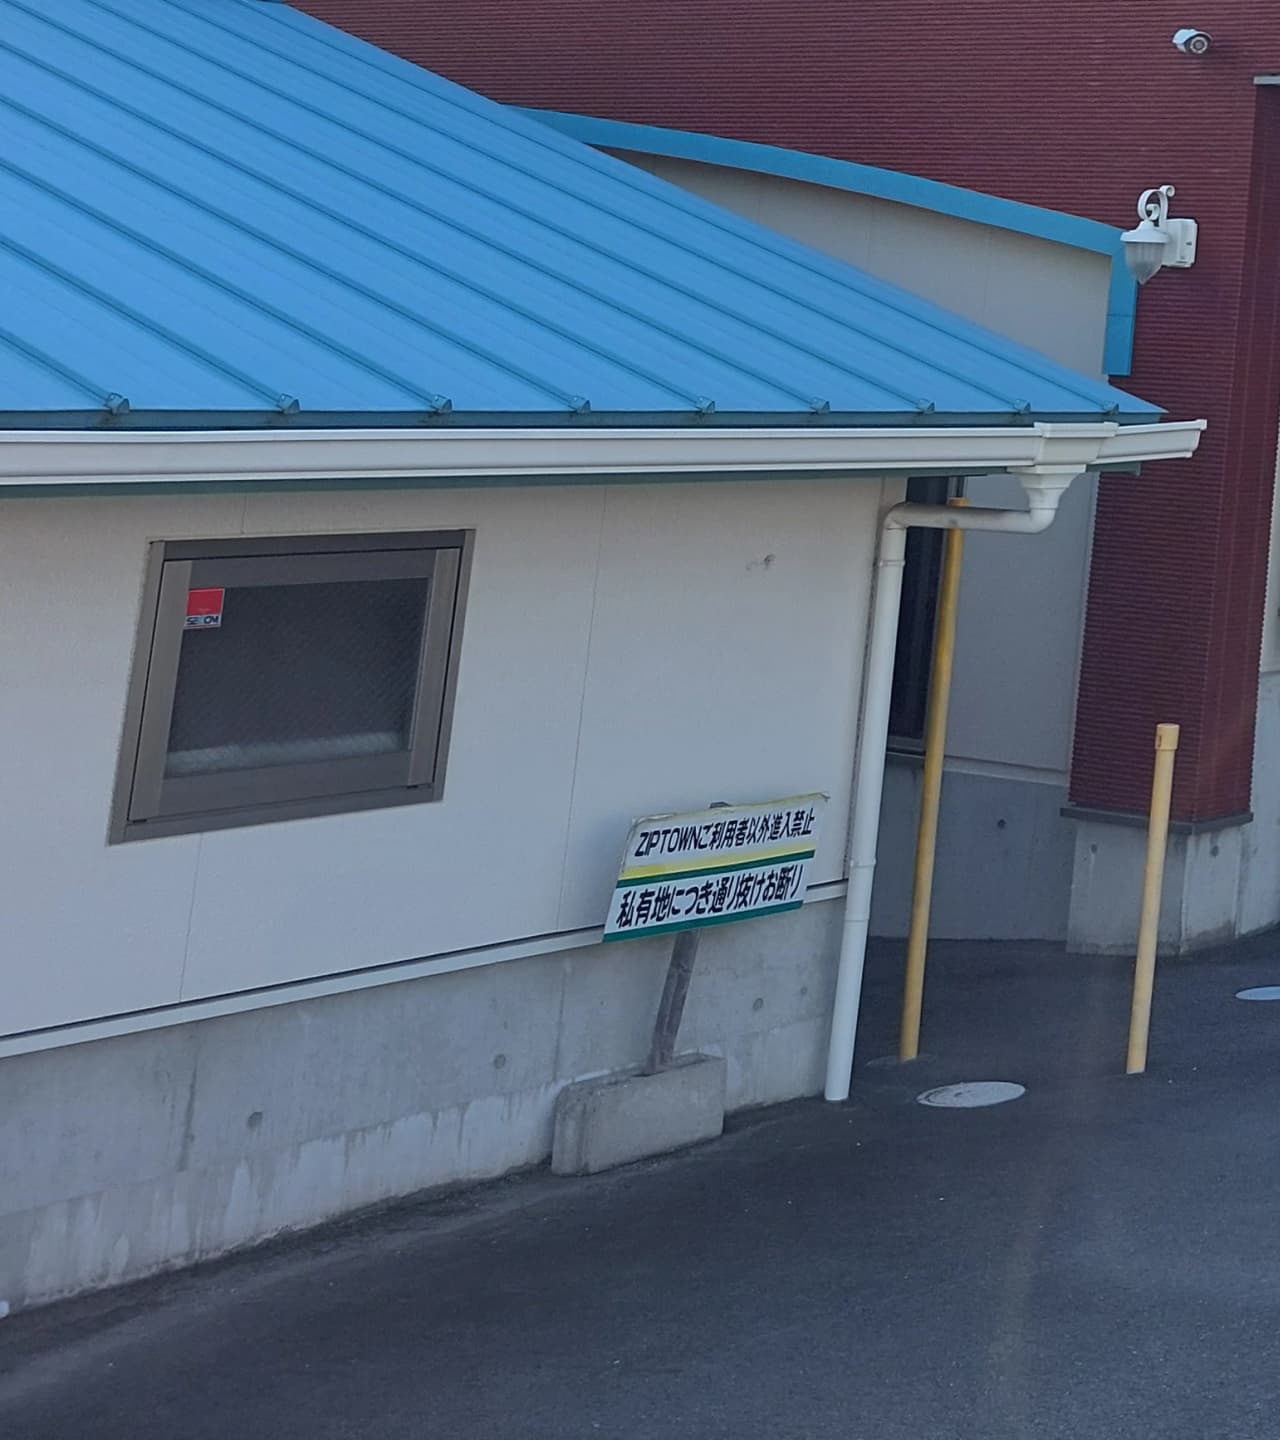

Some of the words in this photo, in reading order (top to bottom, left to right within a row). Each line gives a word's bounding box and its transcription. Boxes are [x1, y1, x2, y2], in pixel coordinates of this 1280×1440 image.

[634, 808, 815, 857] ZIPTOWNご利用者以外進入禁止
[616, 864, 803, 928] 私有地につき通り抜けお断り
